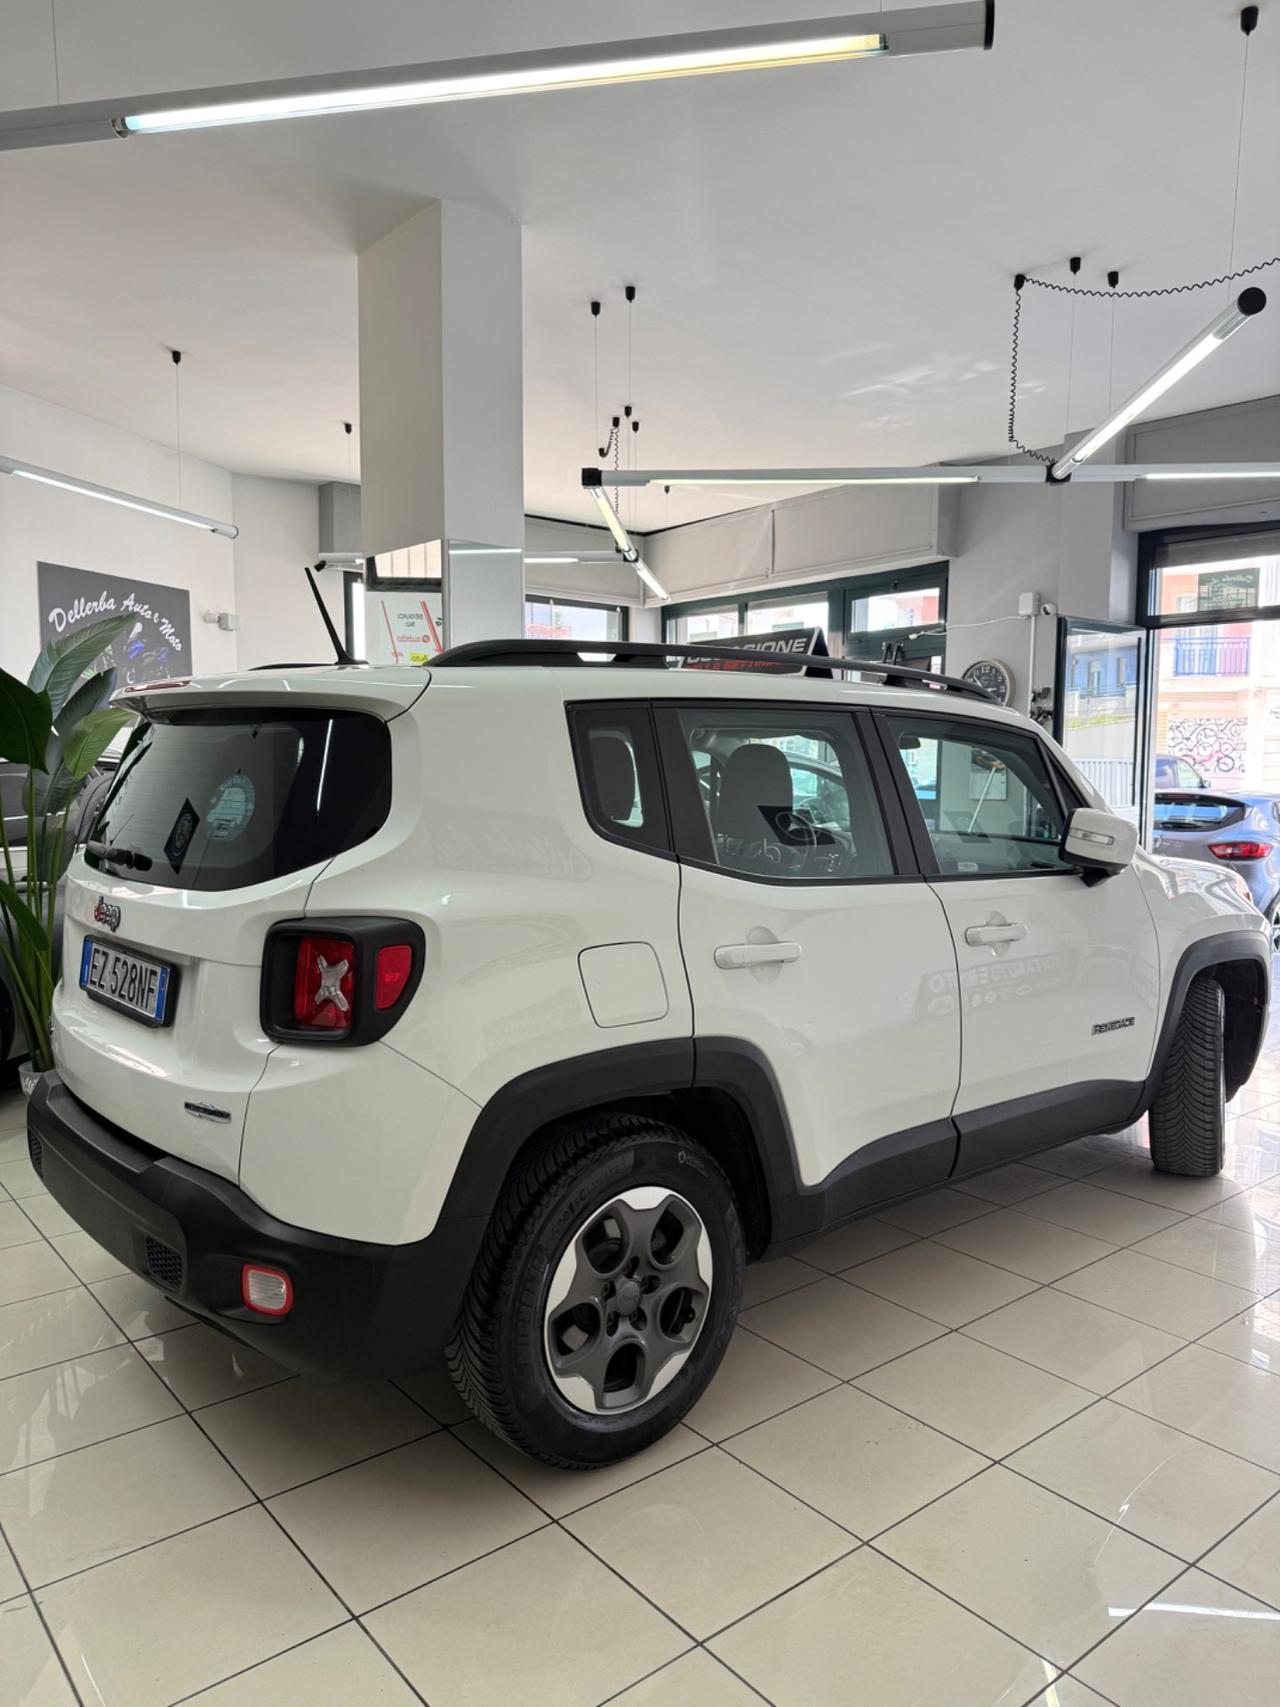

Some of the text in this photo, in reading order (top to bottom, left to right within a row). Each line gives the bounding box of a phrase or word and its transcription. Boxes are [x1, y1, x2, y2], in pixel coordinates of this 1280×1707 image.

[48, 590, 117, 632] Dellerba
[120, 592, 152, 619] Auto
[159, 618, 182, 651] Moto
[94, 896, 121, 932] Jeep
[89, 948, 109, 989] EZ
[1092, 1017, 1135, 1035] RENEGADE
